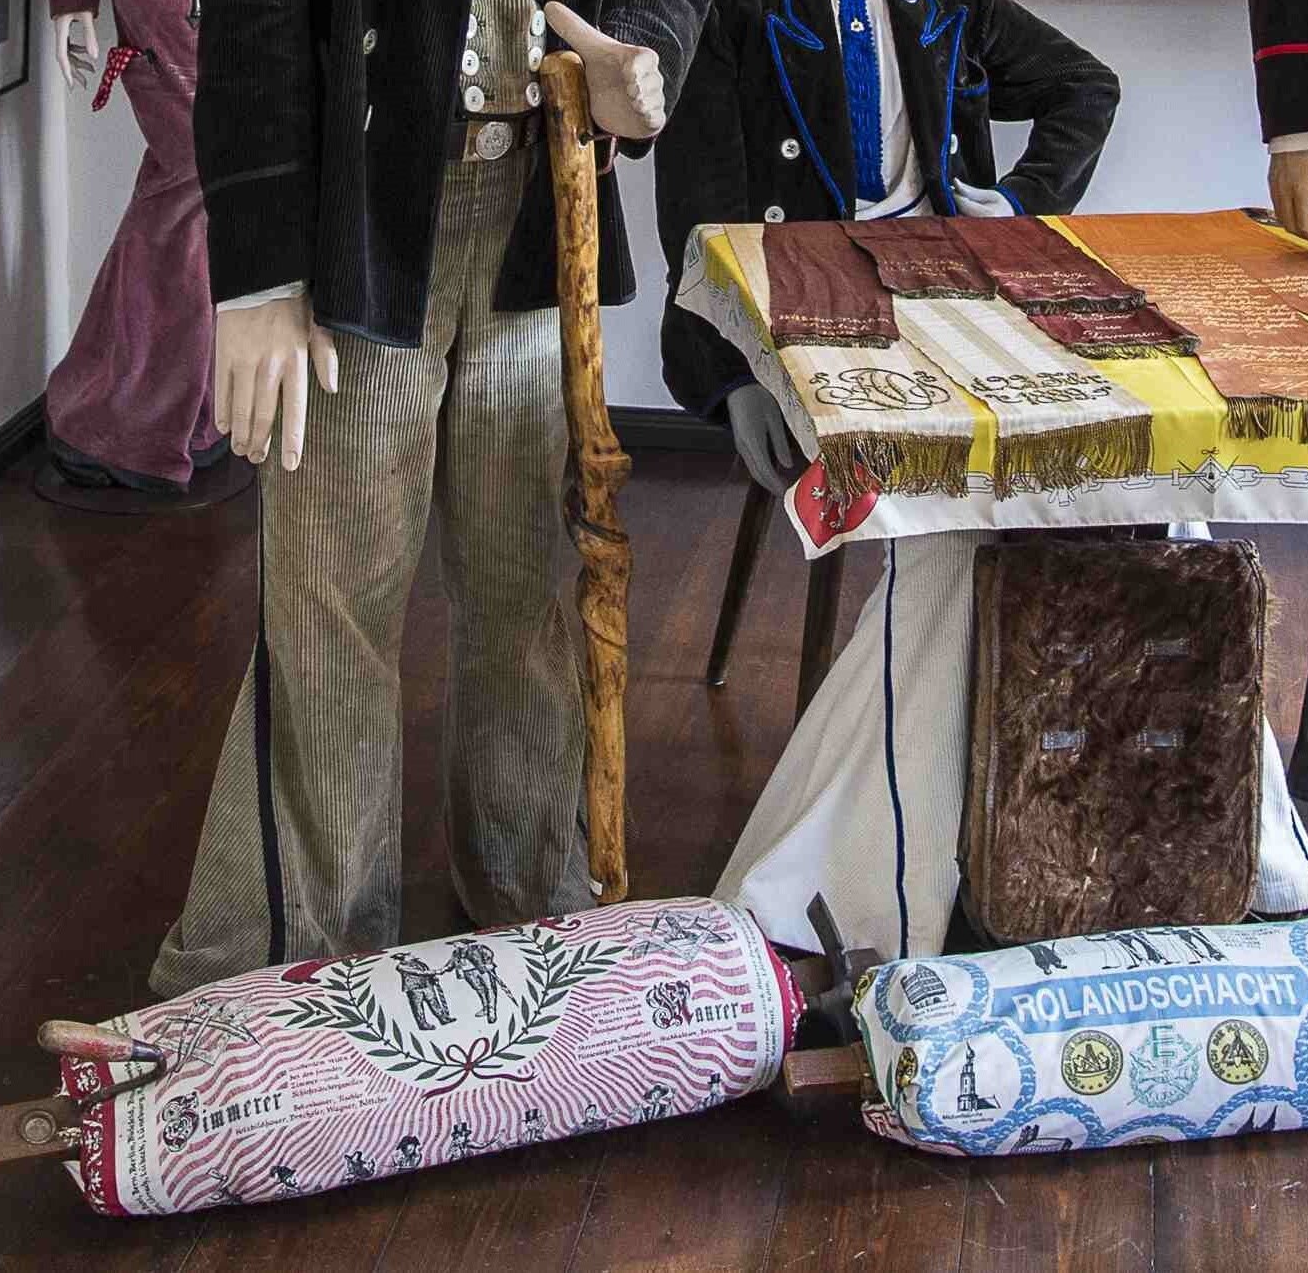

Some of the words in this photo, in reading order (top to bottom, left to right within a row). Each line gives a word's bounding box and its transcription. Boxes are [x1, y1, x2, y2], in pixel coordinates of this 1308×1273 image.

[1012, 974, 1299, 1023] ROLANDSCHACHT
[137, 1094, 145, 1137] Lüneburg,
[162, 1090, 284, 1153] Zimmerer
